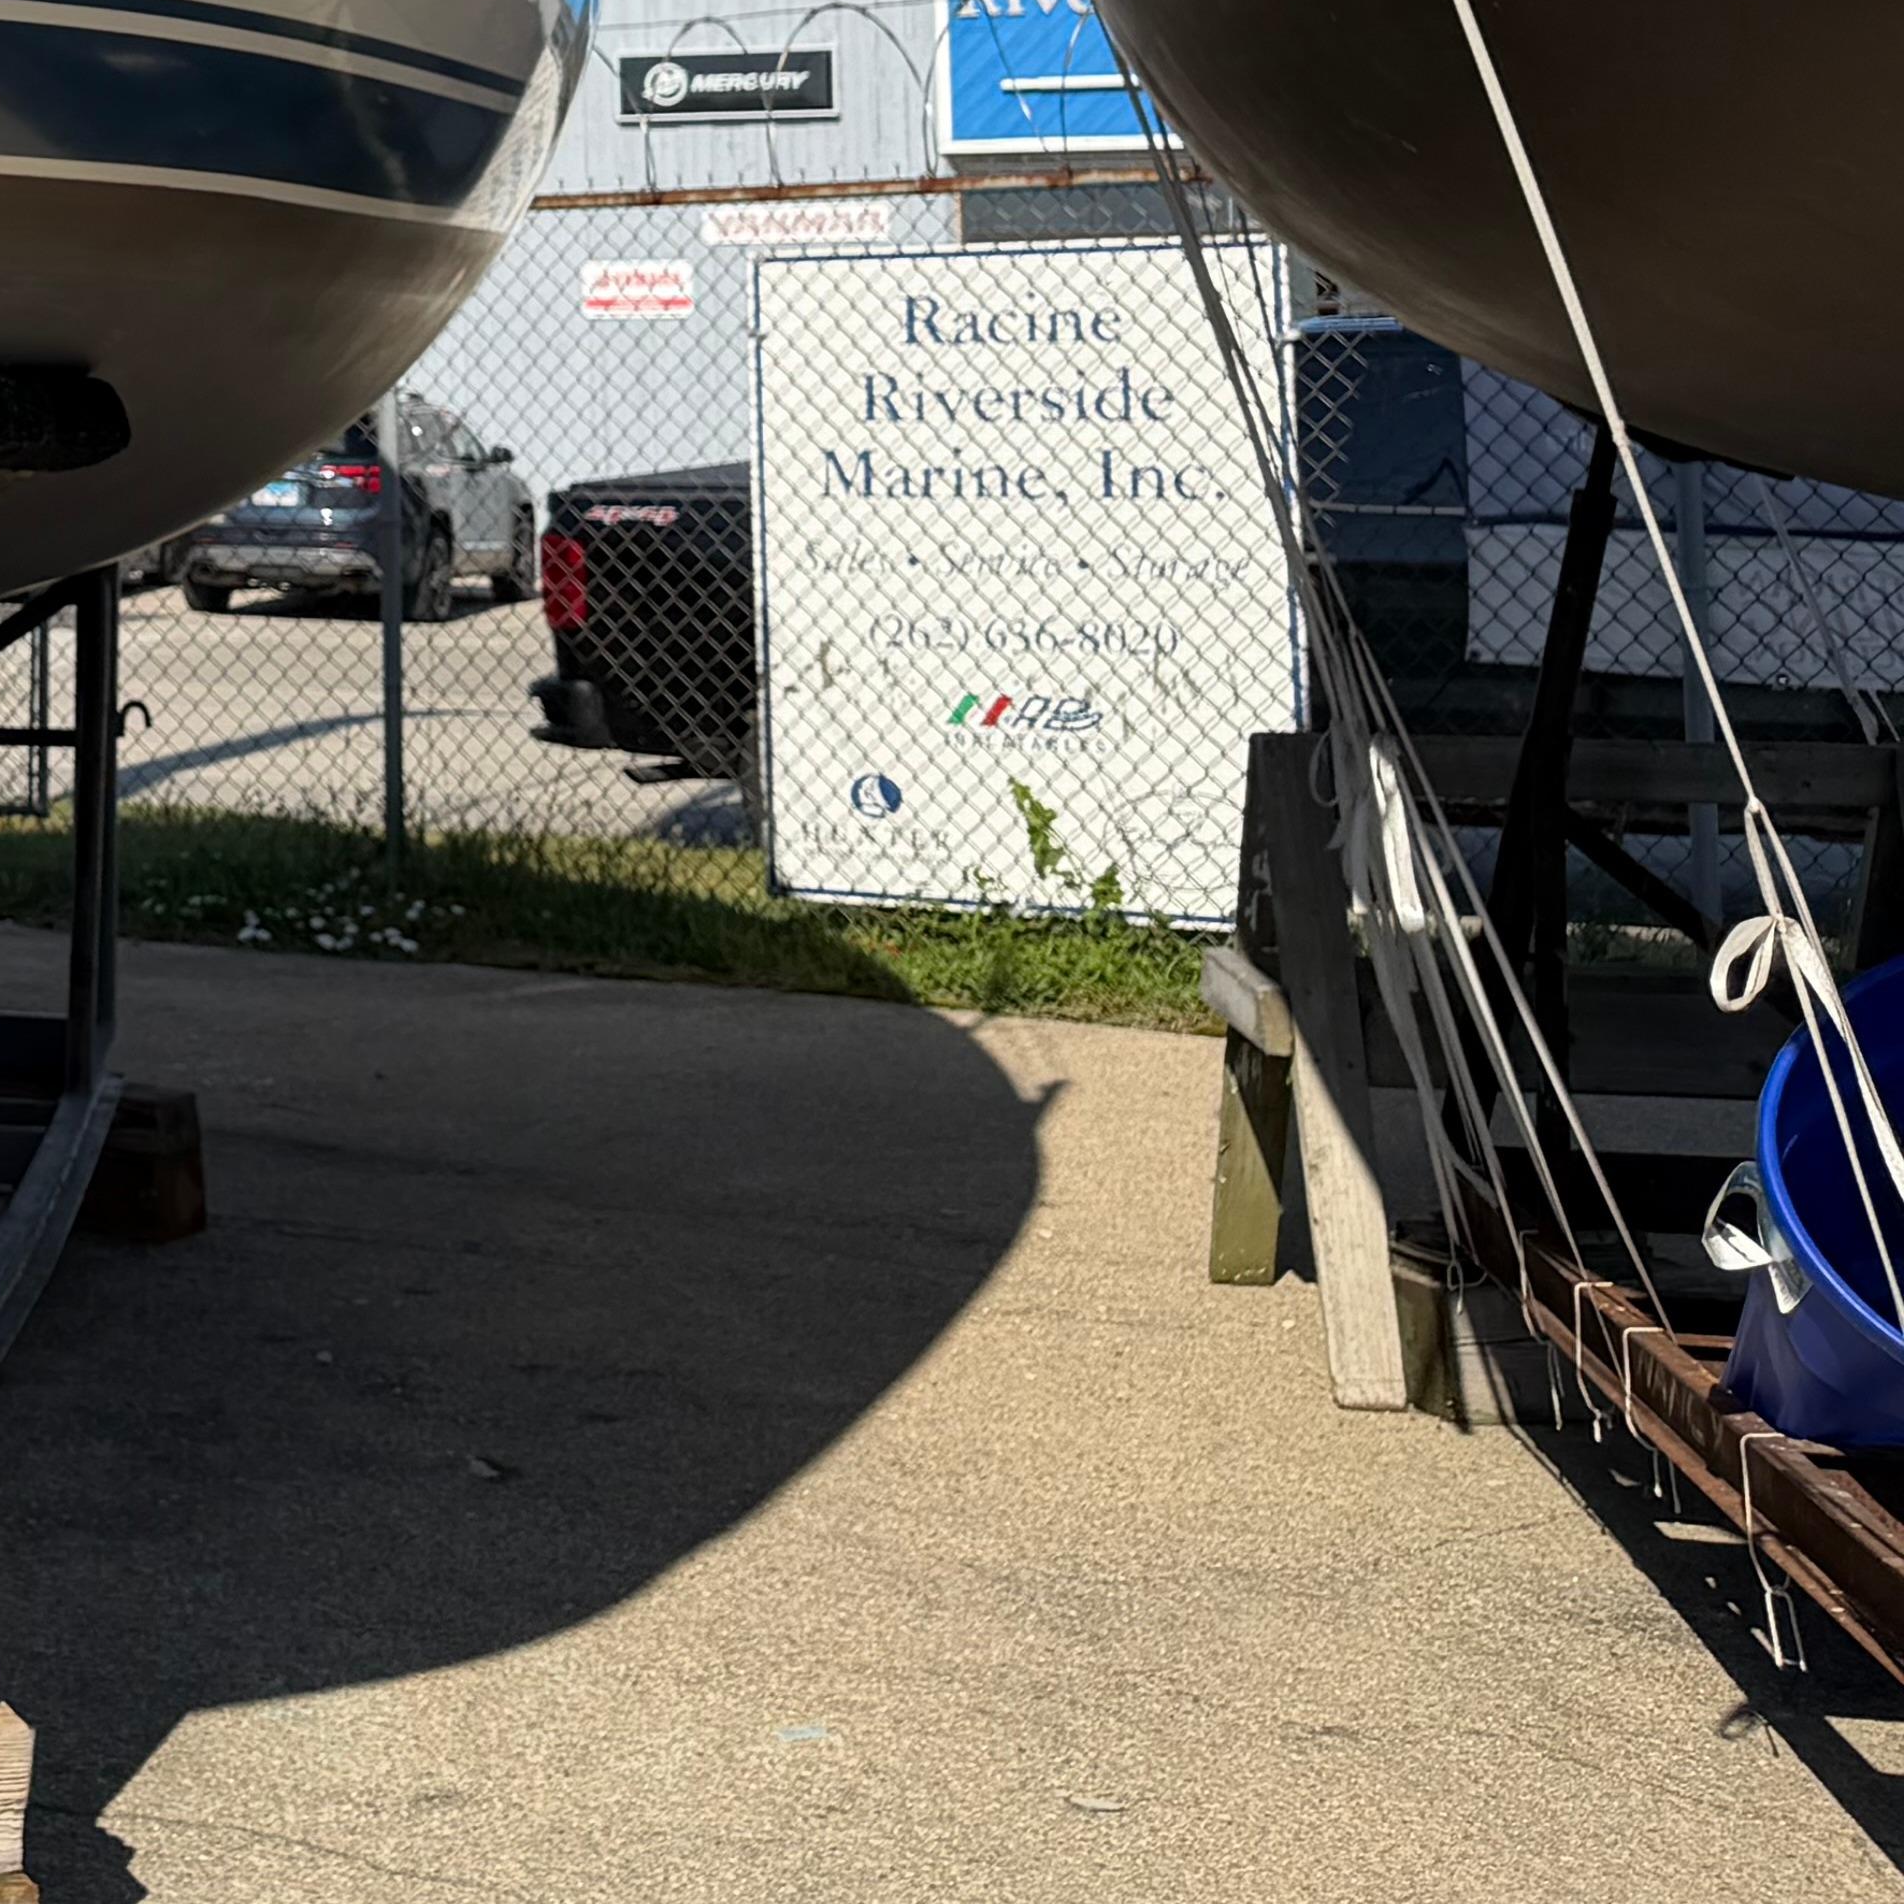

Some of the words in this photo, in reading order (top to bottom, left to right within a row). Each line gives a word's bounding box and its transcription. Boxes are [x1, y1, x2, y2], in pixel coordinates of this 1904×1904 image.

[690, 70, 810, 93] MERCURY
[903, 292, 1123, 346] Racine
[863, 367, 1175, 422] Riverside
[821, 447, 1069, 507] Marine,
[1098, 448, 1226, 500] Inc.
[805, 538, 889, 575] Sales
[938, 539, 1063, 578] Service
[1109, 544, 1252, 592] Storage
